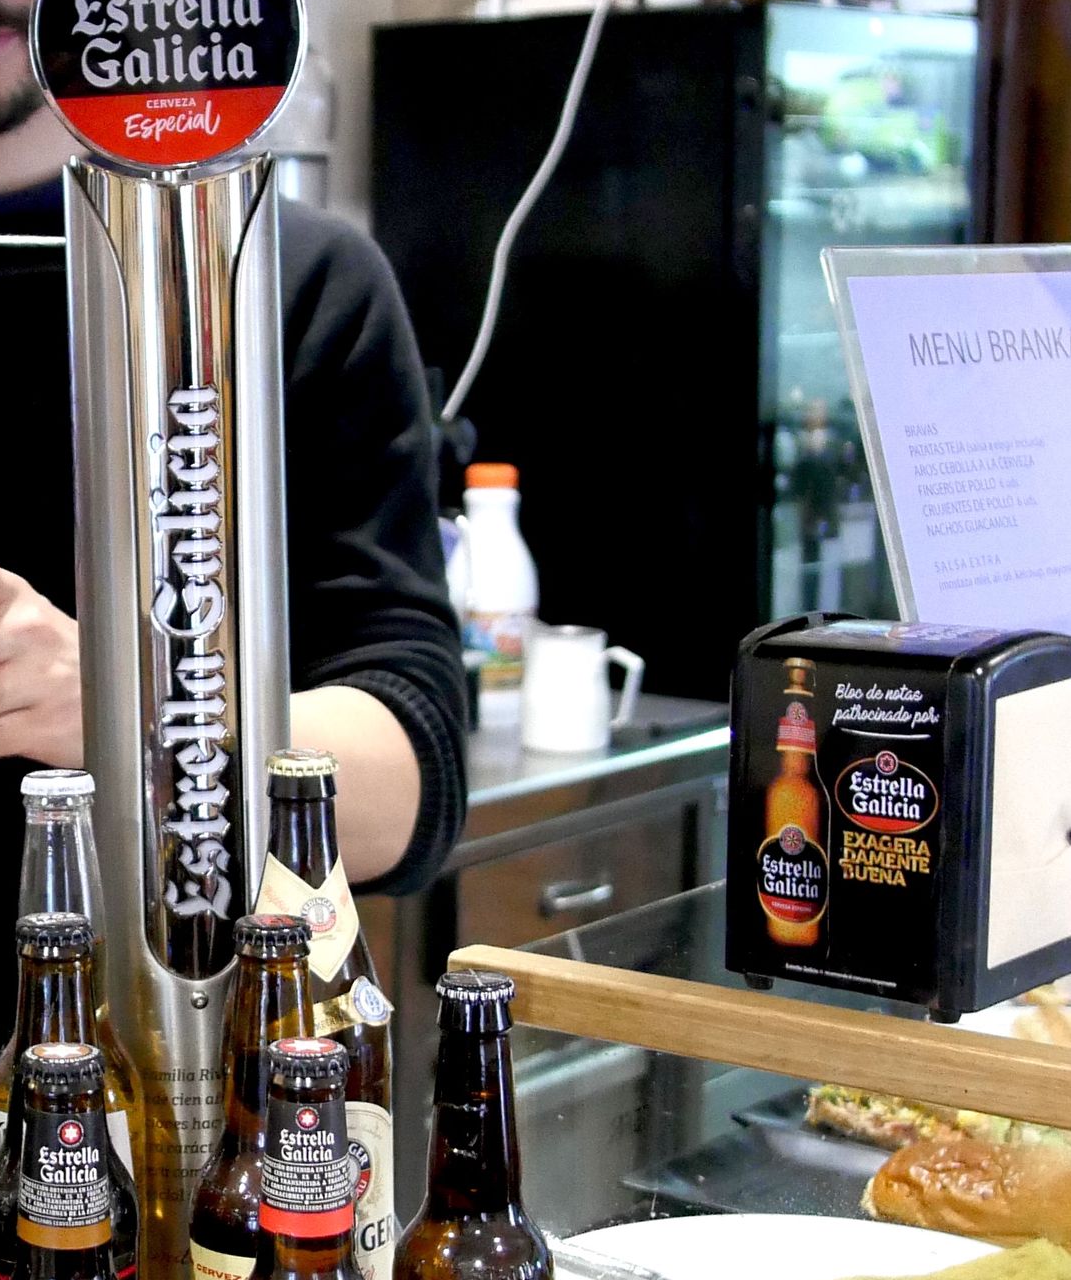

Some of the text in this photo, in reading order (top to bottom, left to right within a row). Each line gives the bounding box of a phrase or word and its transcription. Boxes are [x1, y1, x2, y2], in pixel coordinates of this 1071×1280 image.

[81, 32, 257, 88] Galicia
[146, 97, 196, 109] CERVEZA
[124, 100, 221, 141] Especial
[908, 326, 1071, 368] MENU BRANK
[905, 423, 938, 437] BRAVAS
[147, 385, 232, 921] Estrella Galicia
[835, 683, 923, 703] Bloc de notas
[832, 705, 912, 725] patrocinado
[849, 772, 926, 800] Estrella
[852, 792, 920, 820] Galicia
[843, 830, 931, 858] EXAGERA
[761, 853, 822, 880] Estrella
[842, 848, 930, 874] DAMENTE
[763, 874, 819, 899] Galicia
[840, 864, 907, 887] BUENA
[279, 1129, 335, 1147] Estrella
[38, 1146, 99, 1165] Estrella
[281, 1145, 333, 1162] Galicia
[40, 1164, 98, 1183] Galicia
